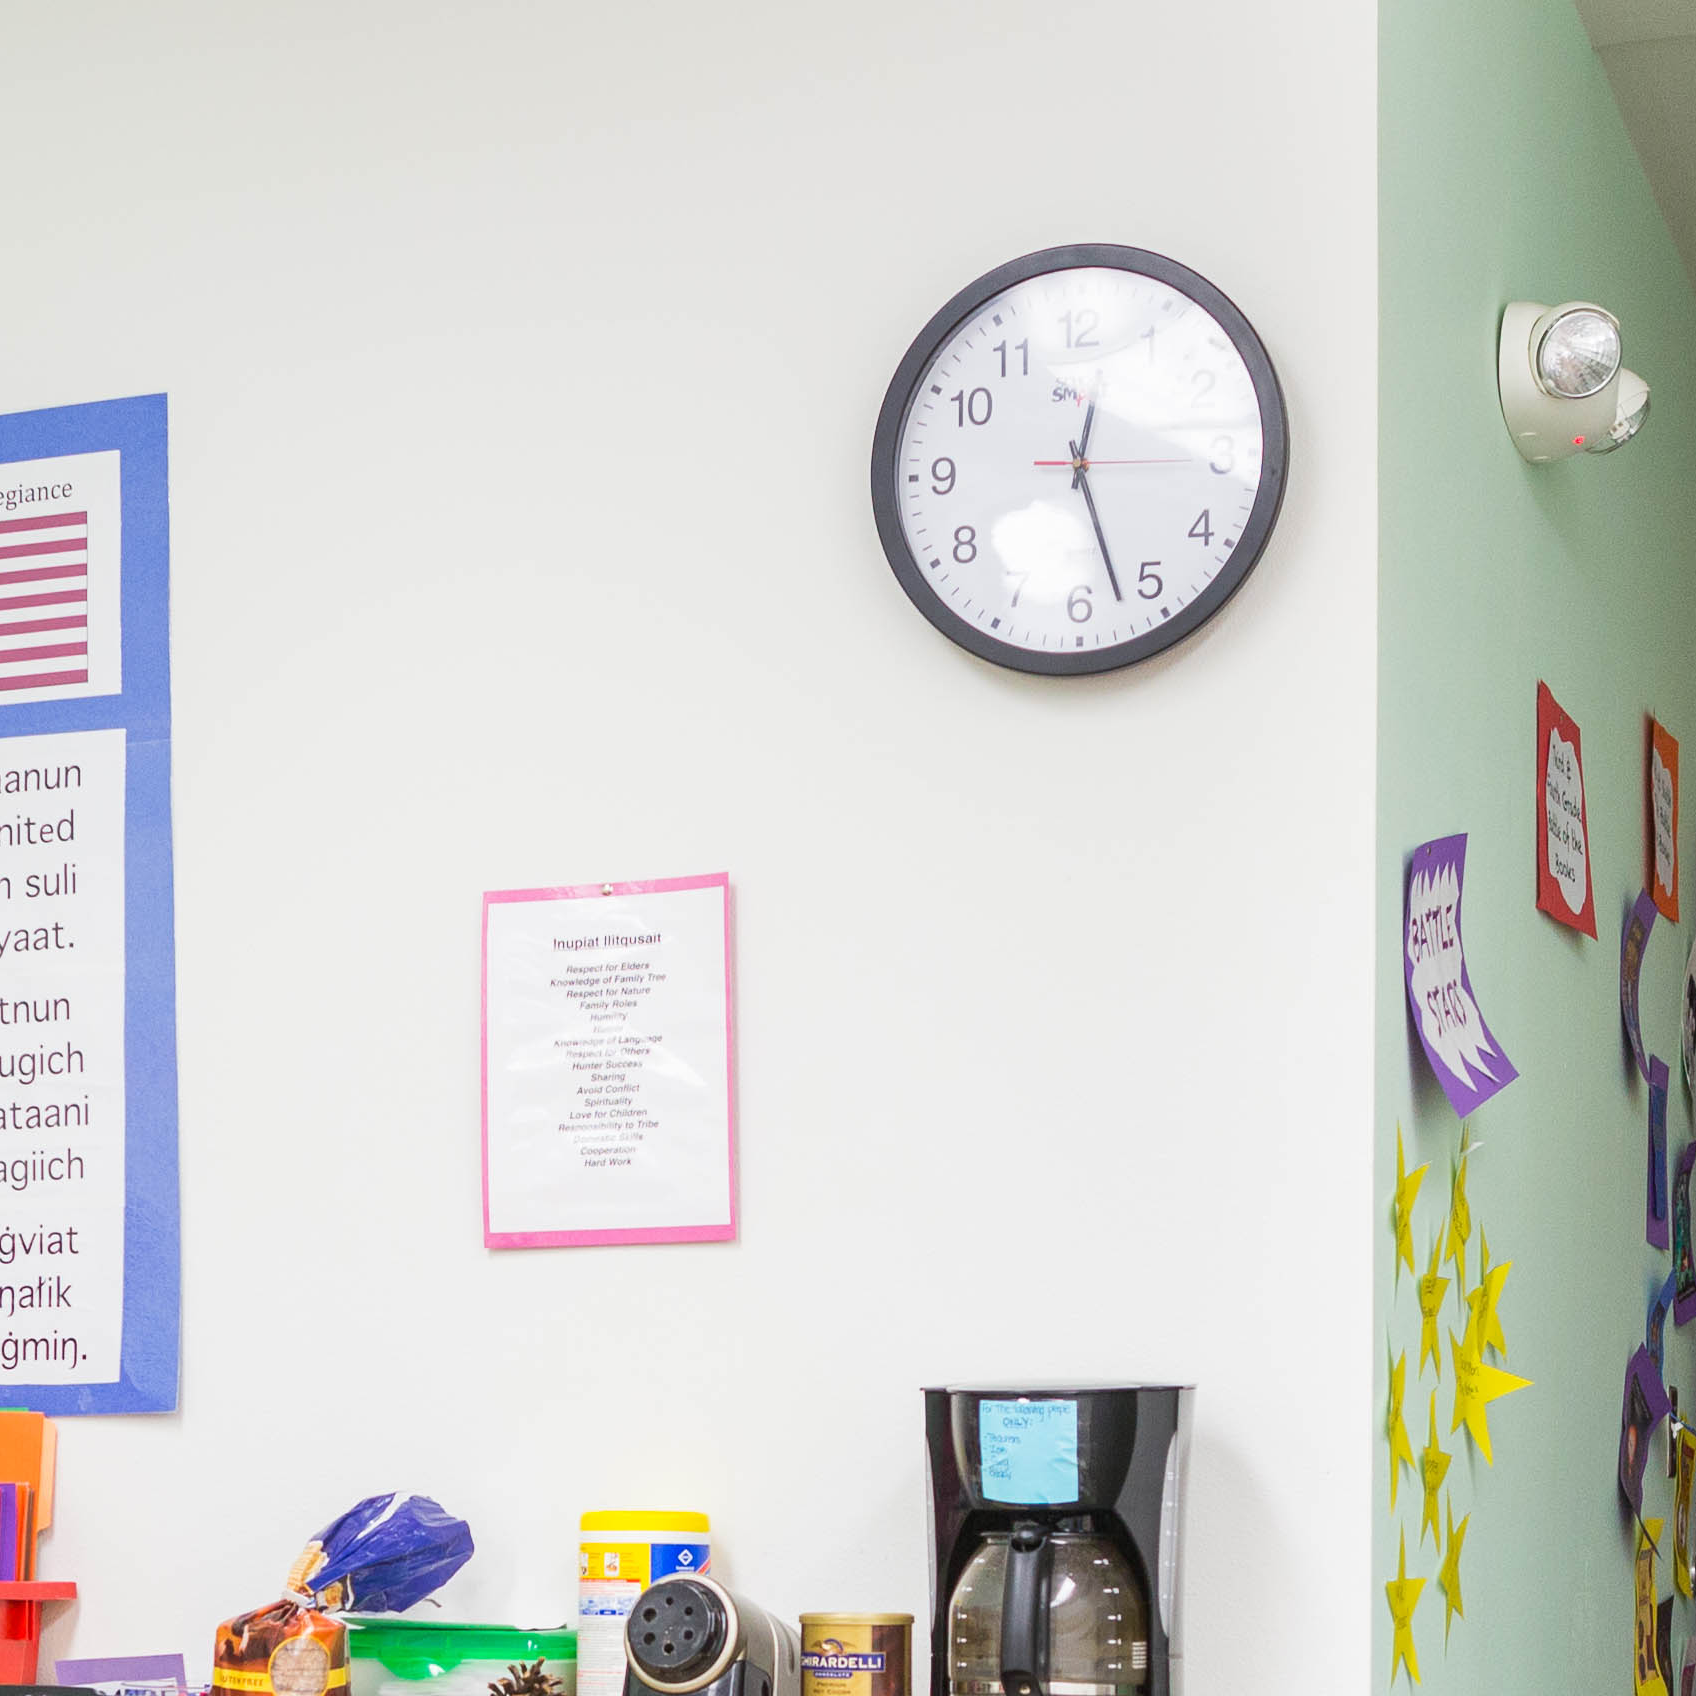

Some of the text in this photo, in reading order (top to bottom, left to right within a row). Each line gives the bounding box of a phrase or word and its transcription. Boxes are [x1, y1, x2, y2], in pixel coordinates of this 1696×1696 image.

[1058, 309, 1099, 349] 12
[1141, 326, 1157, 365] 1
[993, 338, 1029, 377] 11
[950, 387, 993, 427] 10
[1190, 370, 1216, 409] 2
[1209, 436, 1235, 475] 3
[931, 457, 956, 495] 9
[953, 526, 977, 564] 8
[1188, 509, 1215, 546] 4
[1005, 570, 1029, 607] 7
[1138, 562, 1163, 599] 5
[1067, 585, 1093, 623] 6
[24, 863, 77, 898] suli
[1411, 902, 1454, 963] BATTLE
[551, 973, 666, 987] Knowledge of Family Tree
[567, 965, 602, 974] Respect
[621, 962, 649, 971] Elders
[567, 987, 650, 999] Respect for Nature
[580, 1000, 637, 1010] Family Roles
[1425, 979, 1469, 1038] STARS
[572, 1062, 602, 1070] Hunter
[591, 1073, 625, 1082] Sharing
[577, 1084, 639, 1095] Avoid Conflict
[584, 1097, 632, 1107] Spirituality
[594, 1111, 607, 1119] for
[610, 1109, 647, 1118] Children
[637, 1120, 659, 1128] Tribe
[585, 1158, 631, 1167] Hard Work
